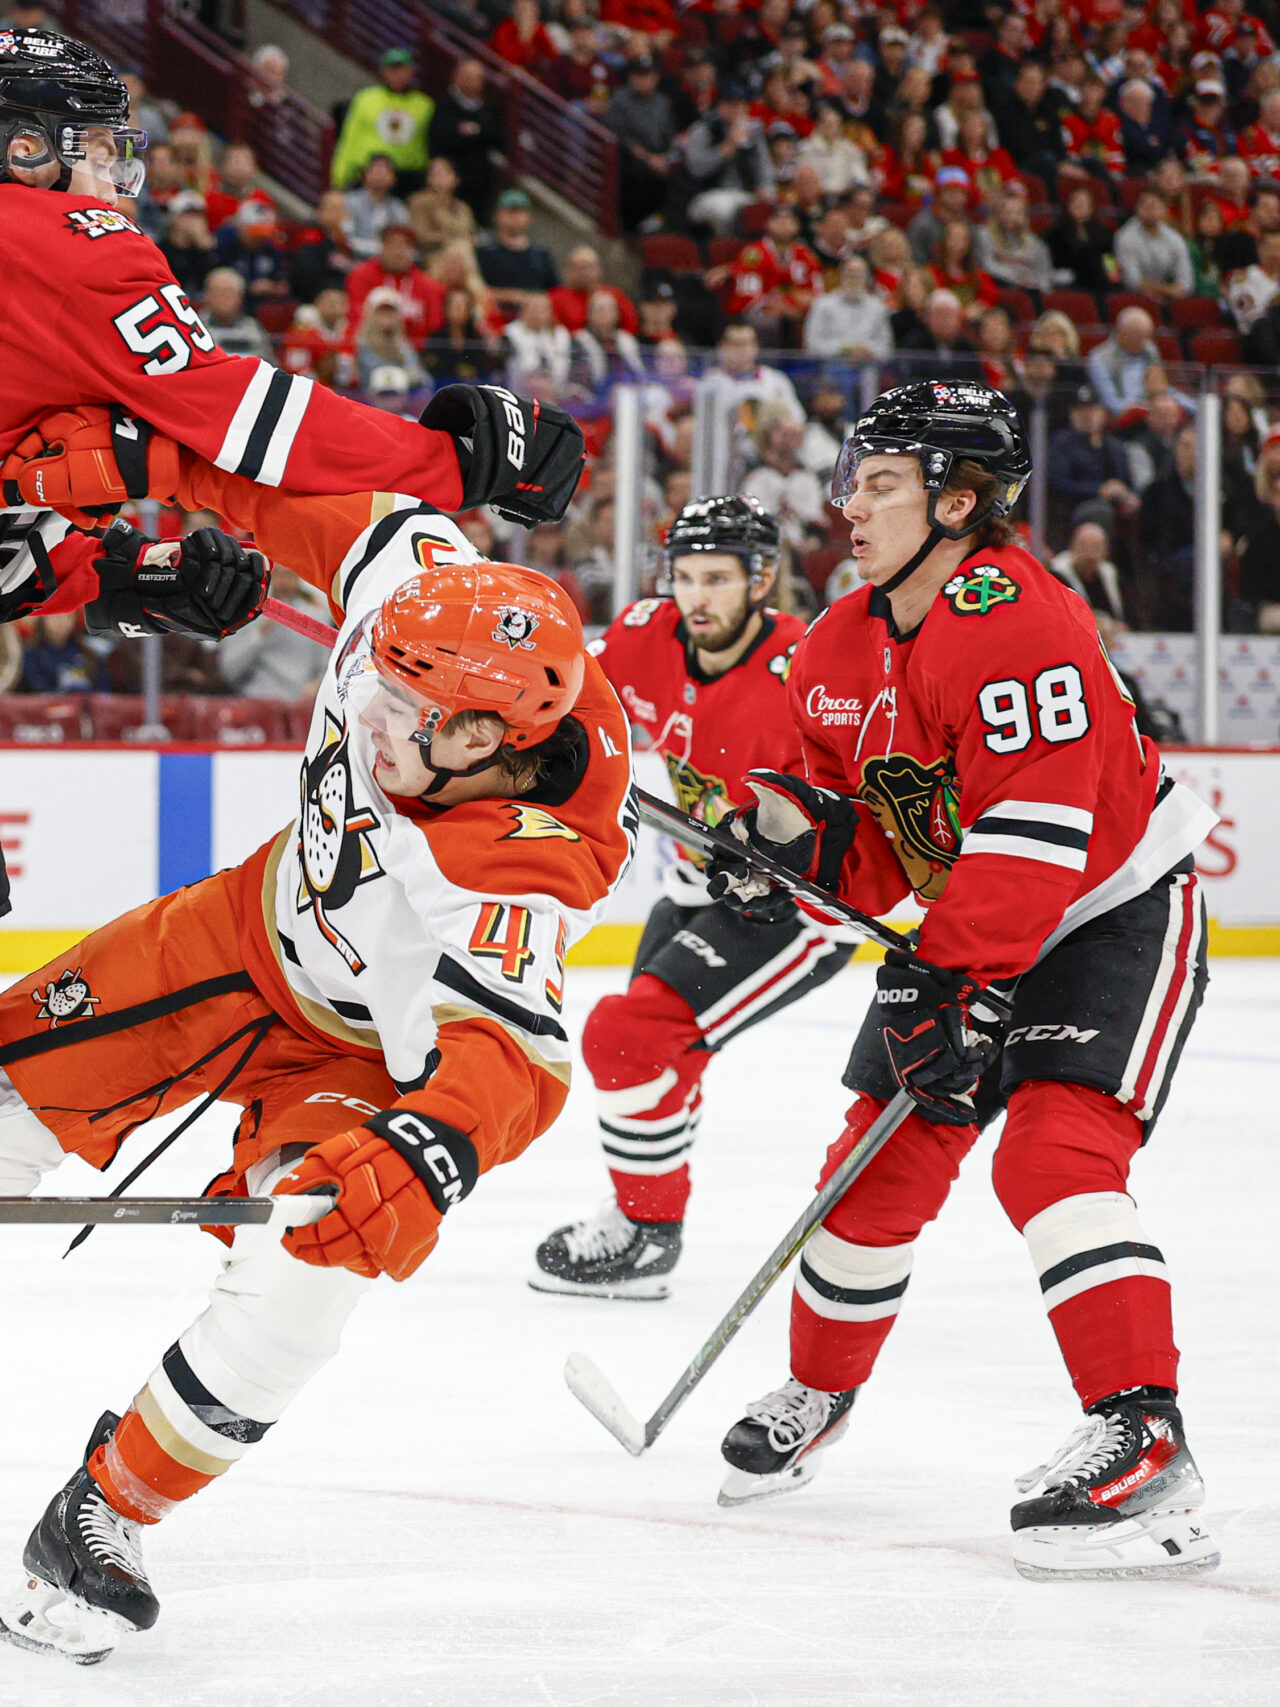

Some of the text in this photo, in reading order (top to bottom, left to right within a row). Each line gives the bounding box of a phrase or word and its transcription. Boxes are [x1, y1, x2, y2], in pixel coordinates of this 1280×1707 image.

[23, 36, 64, 49] BELLE
[27, 45, 58, 57] TIRE
[110, 283, 216, 377] 55
[957, 387, 994, 399] BELLE
[963, 395, 991, 406] TIRE
[36, 470, 47, 502] CCM
[137, 573, 177, 581] BLACKHAWKS
[806, 685, 863, 717] Circa
[977, 662, 1091, 755] 98
[822, 713, 861, 726] SPORTS
[1004, 1024, 1101, 1048] CCM
[304, 1091, 382, 1116] CC
[387, 1113, 464, 1204] CCM
[1101, 1468, 1146, 1502] BAUER
